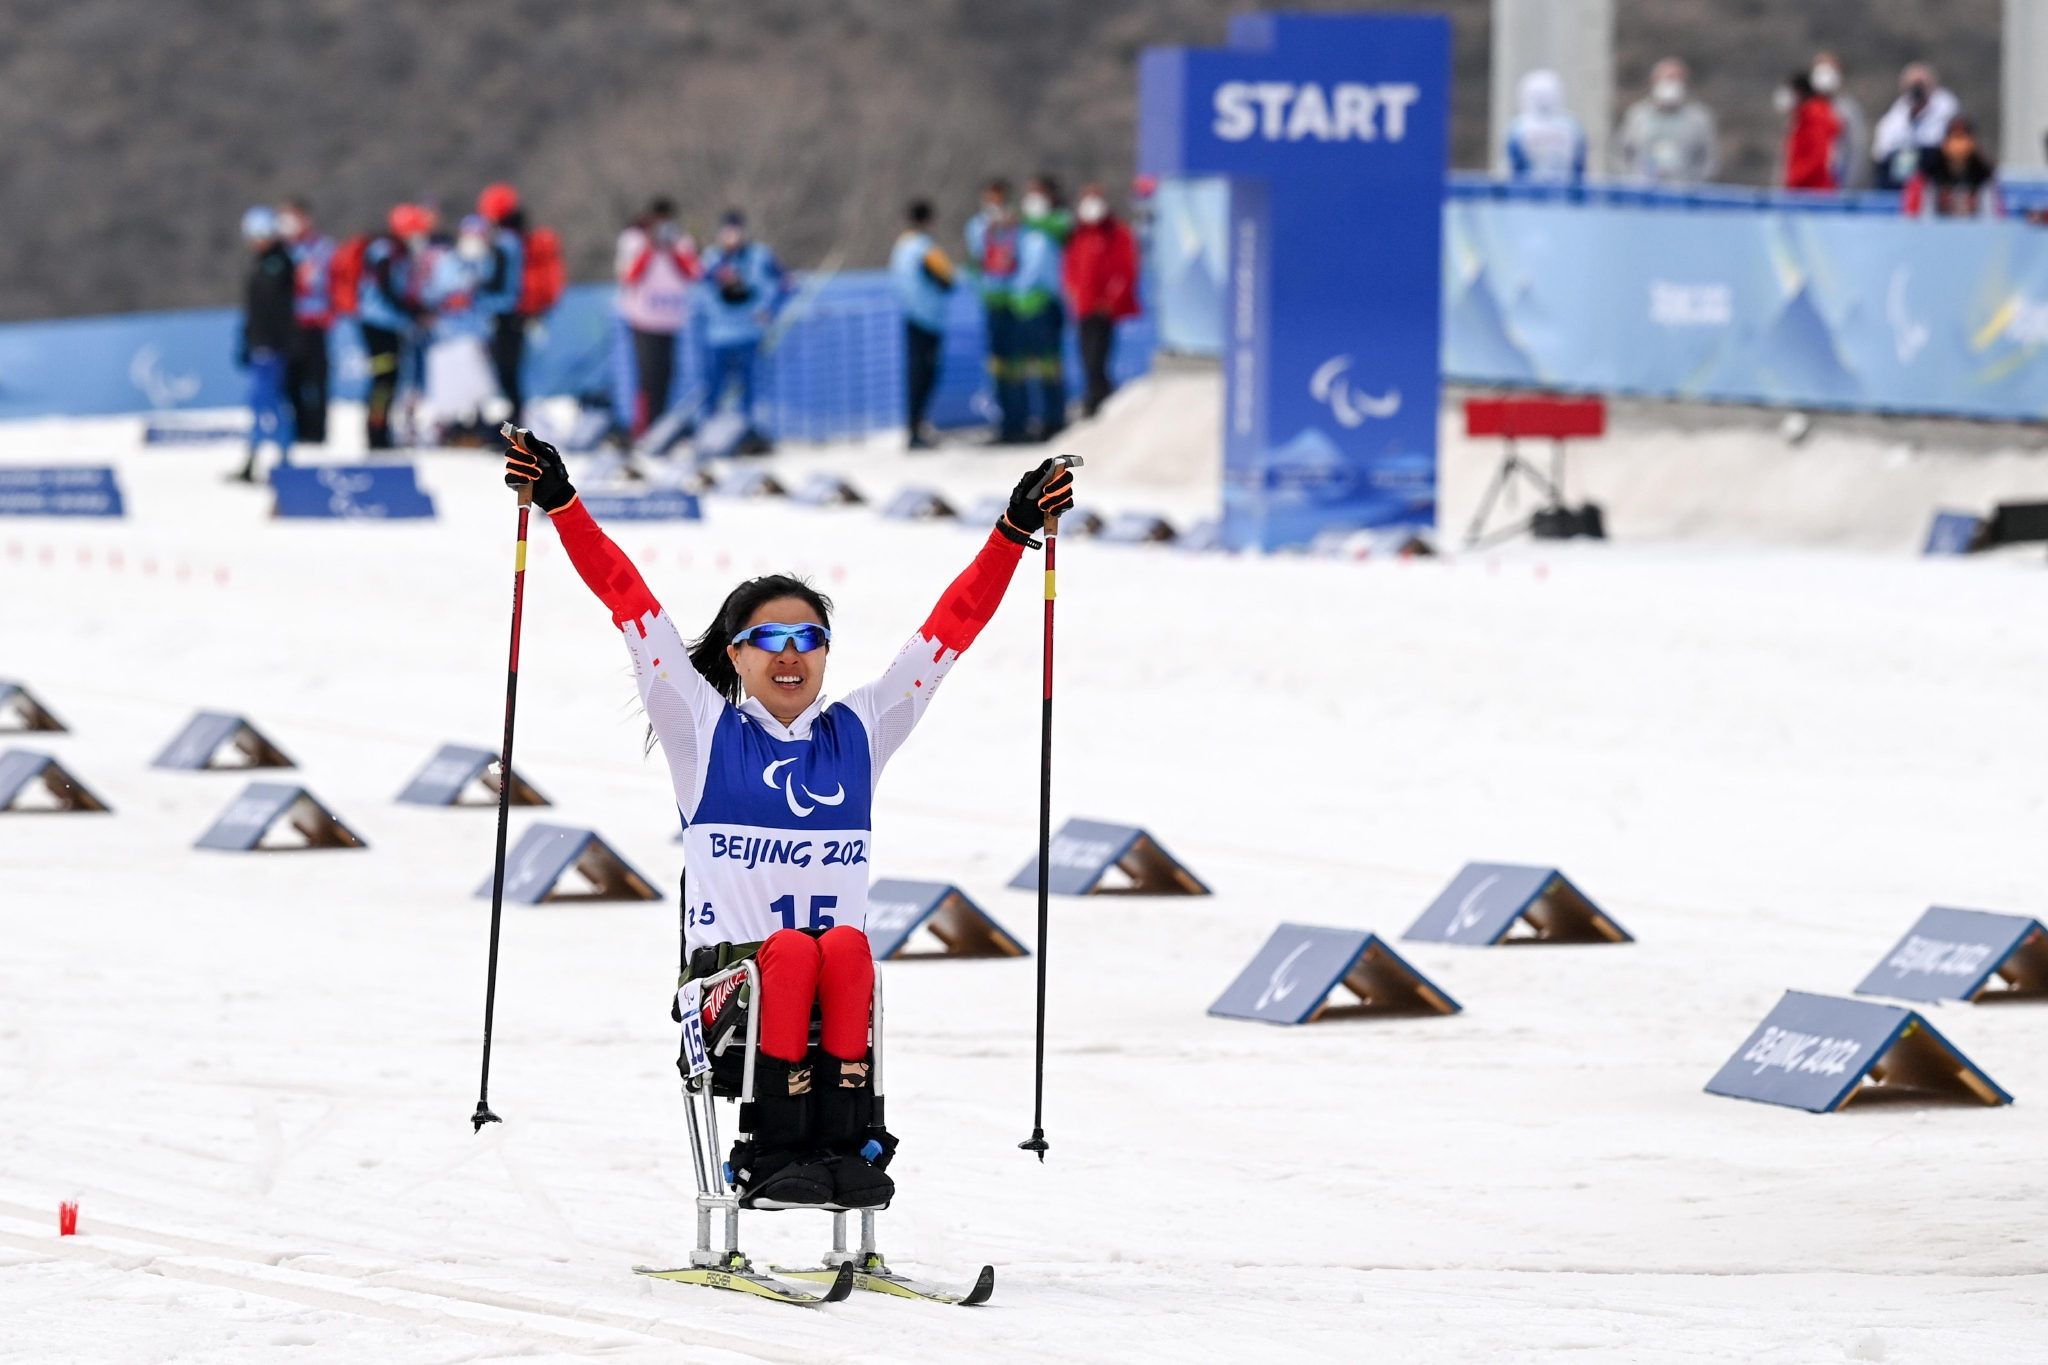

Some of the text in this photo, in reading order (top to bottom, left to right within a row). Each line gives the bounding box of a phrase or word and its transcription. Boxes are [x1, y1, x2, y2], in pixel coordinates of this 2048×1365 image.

[1213, 81, 1419, 141] START
[709, 833, 867, 869] BEIJING 202
[770, 895, 838, 929] 15
[685, 1018, 705, 1067] 15
[1743, 1026, 1861, 1077] BEIJING 2022
[706, 1272, 731, 1287] FISCHER
[853, 1275, 868, 1288] CHER
